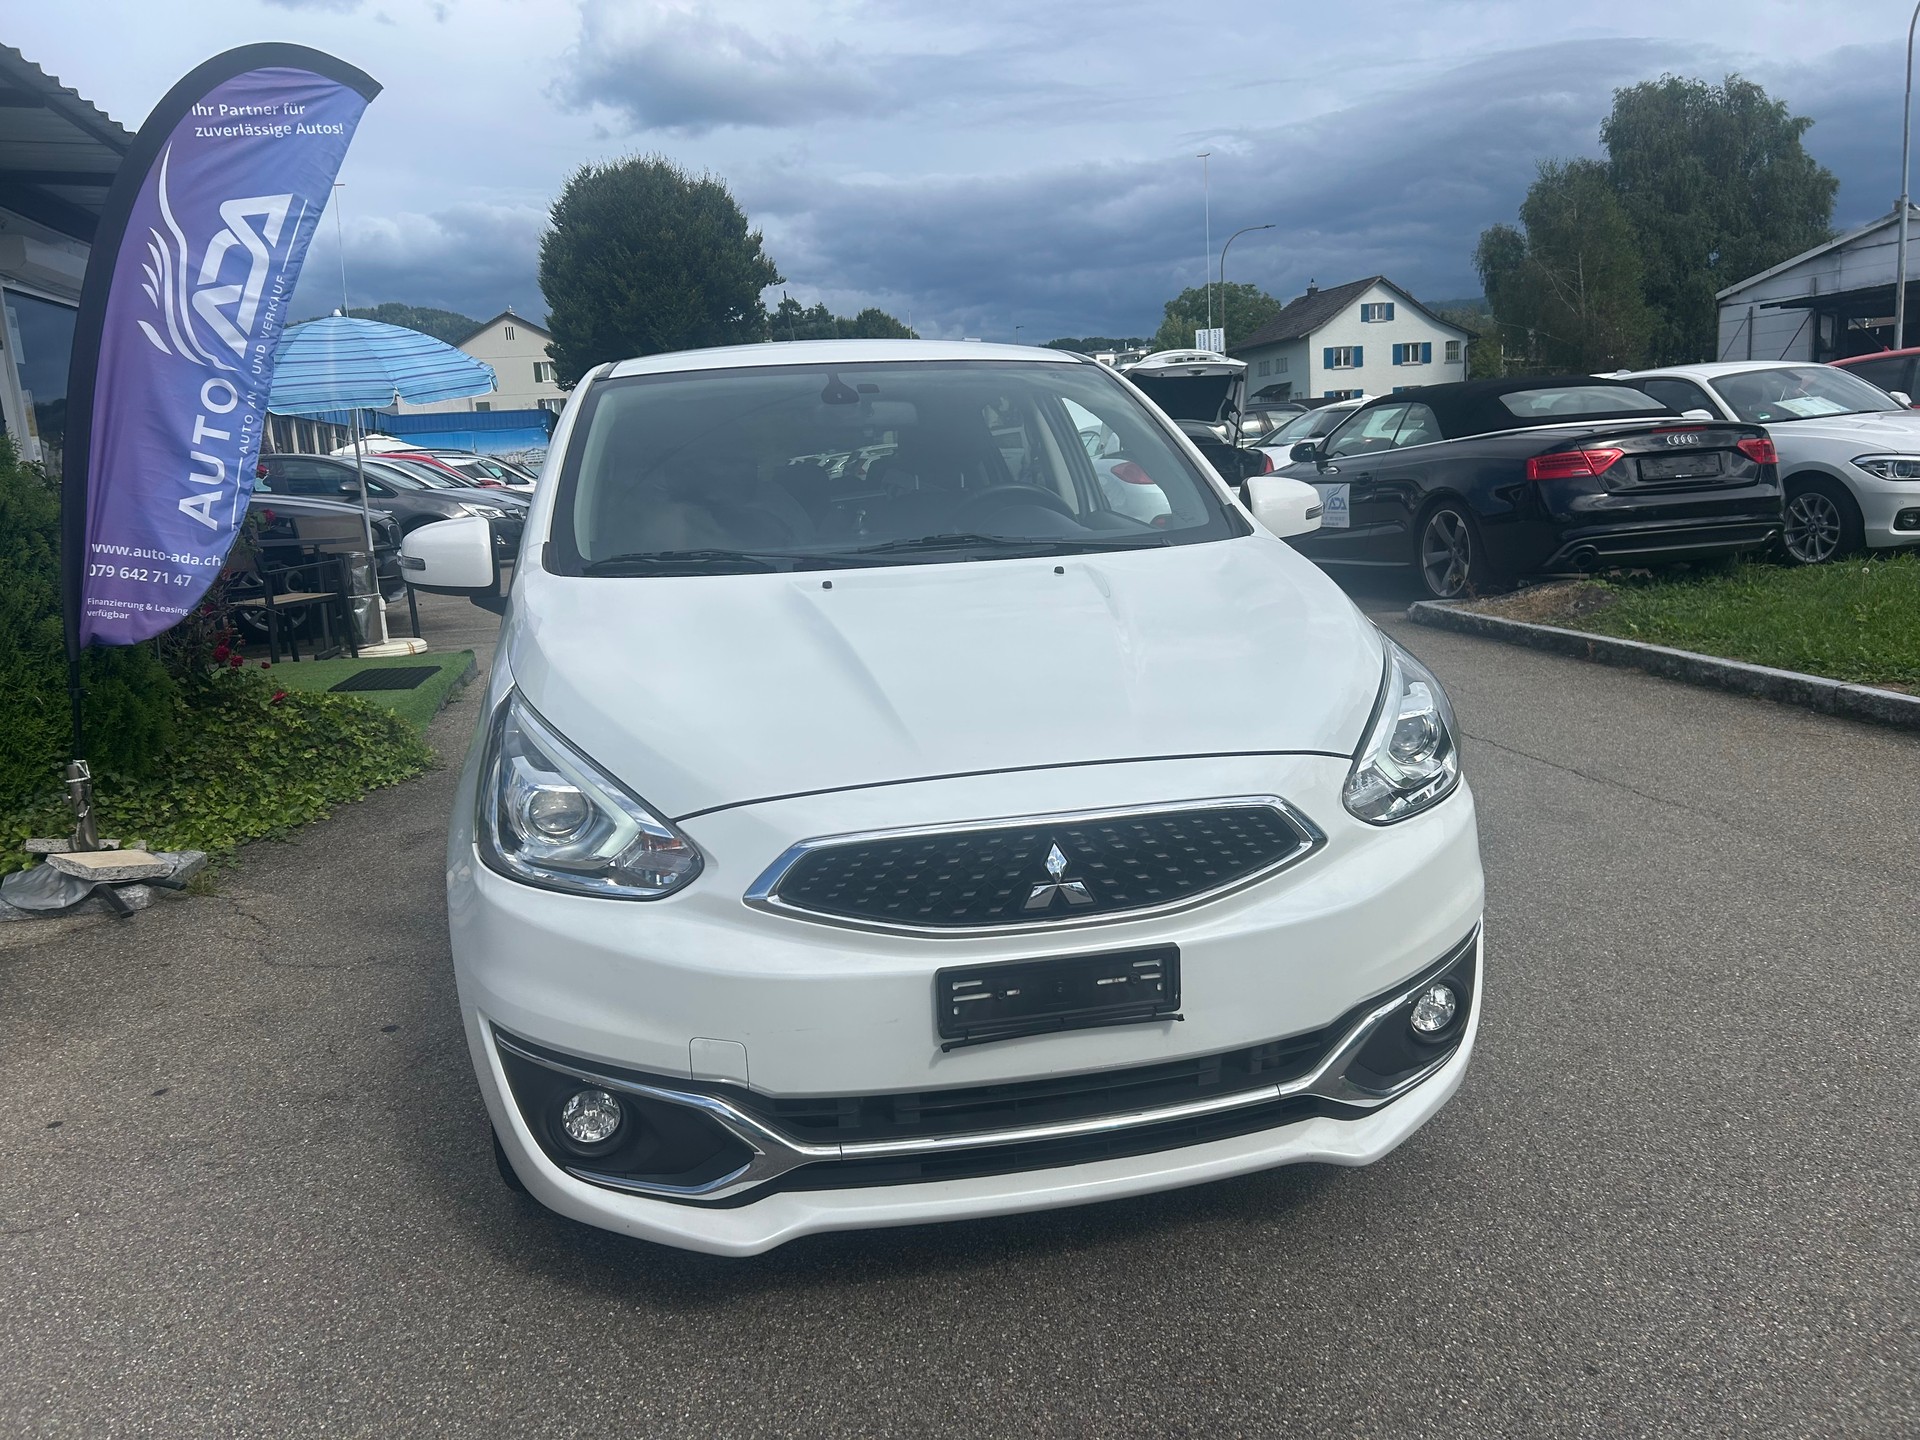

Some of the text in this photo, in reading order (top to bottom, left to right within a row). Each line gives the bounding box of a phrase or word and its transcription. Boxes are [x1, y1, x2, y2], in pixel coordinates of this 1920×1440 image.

[192, 102, 306, 117] Ihr Partner für
[194, 122, 344, 139] zuverlässige Autos!
[239, 414, 255, 455] AUTO
[251, 345, 267, 375] UND
[259, 274, 287, 340] VERKAUF
[178, 377, 239, 532] AUTO
[91, 543, 222, 567] www.auto-ada.ch
[120, 566, 149, 582] 642
[152, 570, 169, 584] 71
[173, 574, 193, 587] 47
[87, 597, 189, 617] Finanzierung & Leasing
[87, 609, 131, 620] verfügbar
